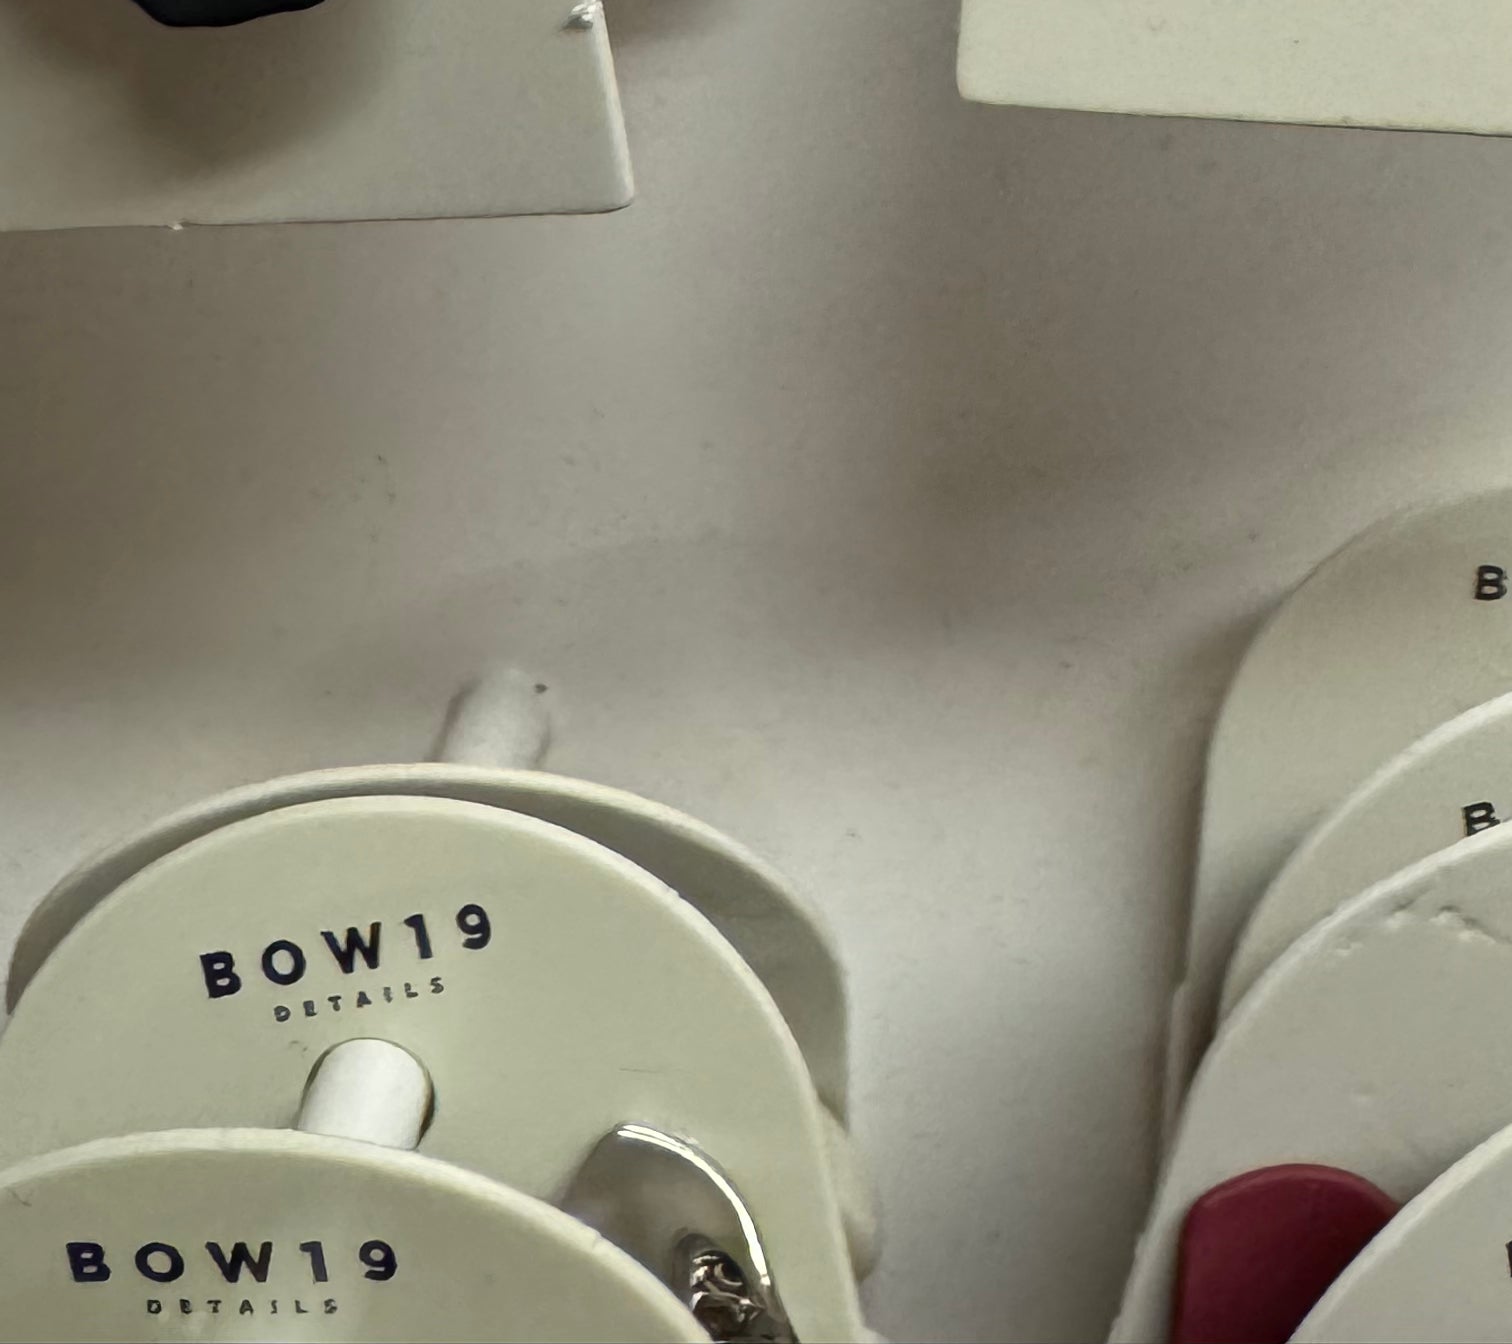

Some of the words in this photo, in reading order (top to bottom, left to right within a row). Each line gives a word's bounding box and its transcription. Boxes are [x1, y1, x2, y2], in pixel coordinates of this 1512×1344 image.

[199, 903, 492, 999] BOW19
[273, 977, 445, 1023] DETAILS
[66, 1240, 398, 1284] BOW19
[146, 1298, 338, 1315] DETAILS
